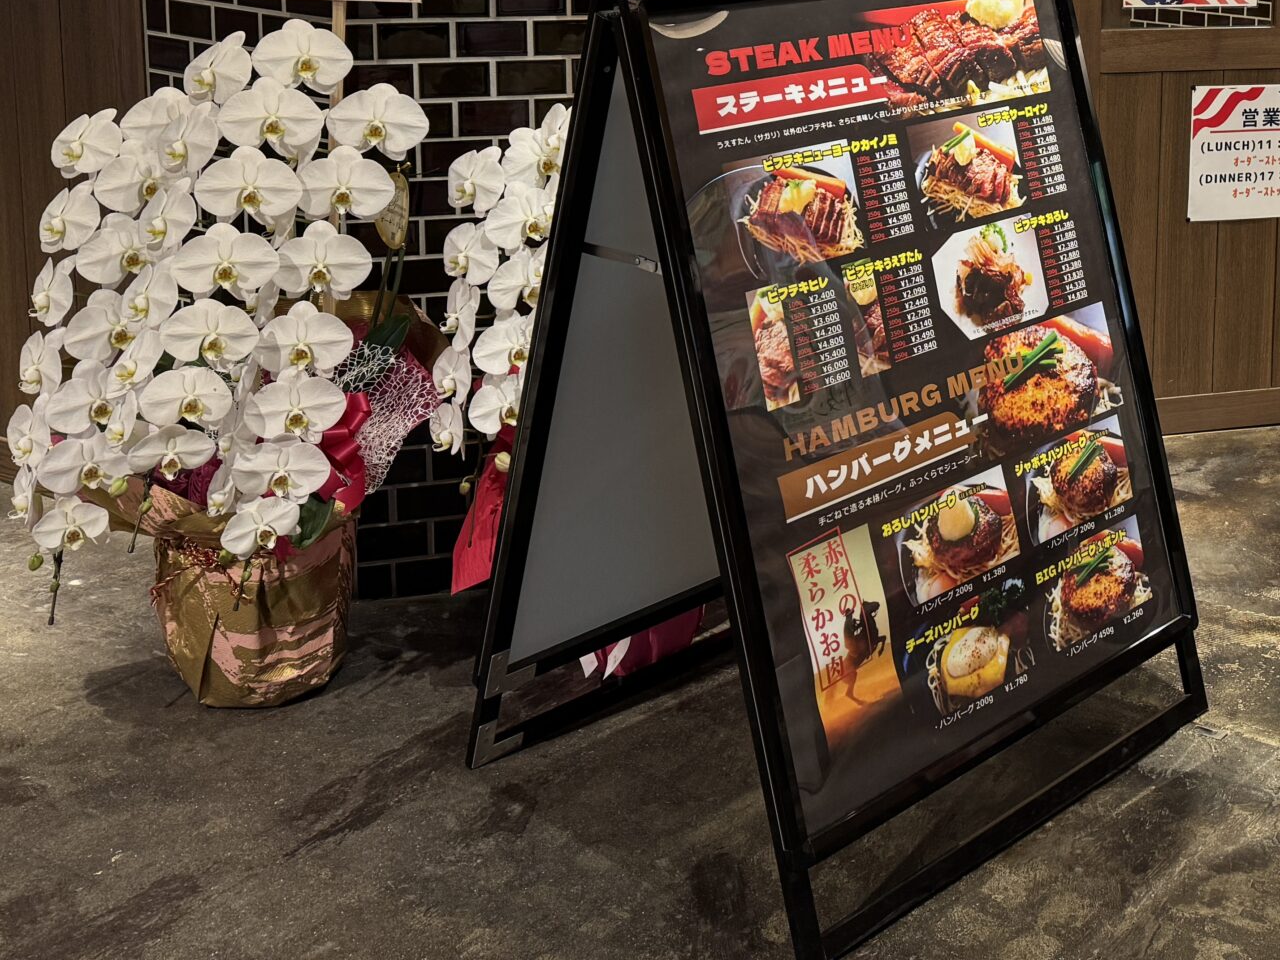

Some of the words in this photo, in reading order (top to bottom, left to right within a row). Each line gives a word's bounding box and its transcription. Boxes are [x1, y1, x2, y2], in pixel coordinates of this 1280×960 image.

[705, 37, 823, 76] STEAK
[828, 24, 913, 59] MENU
[716, 75, 888, 117] ステーキメニュー
[977, 103, 1048, 128] ビフテキサーロイン
[762, 133, 898, 171] ビフテキニューヨークカイノミ
[1014, 210, 1069, 233] ビフテキおろし
[846, 249, 922, 281] ビフテキうえすたん
[767, 277, 829, 304] ビフテキヒレ
[783, 384, 942, 461] HAMBURG
[947, 352, 1024, 399] MENU
[805, 414, 989, 499] ハンバーグメニュー
[1014, 432, 1087, 477] ジャポネハンバーグ
[881, 490, 957, 538] おろしハンバーグ
[1080, 520, 1095, 534] 200g
[823, 540, 857, 616] 赤身の
[1035, 564, 1057, 586] BIG
[1057, 543, 1096, 573] ハンバーグ
[955, 583, 974, 598] 200g
[798, 551, 848, 680] 柔らかお肉
[905, 604, 980, 654] チーズハンバーグ
[1098, 625, 1114, 641] 450g
[939, 705, 974, 730] ハンバーグ
[976, 694, 994, 711] 200g
